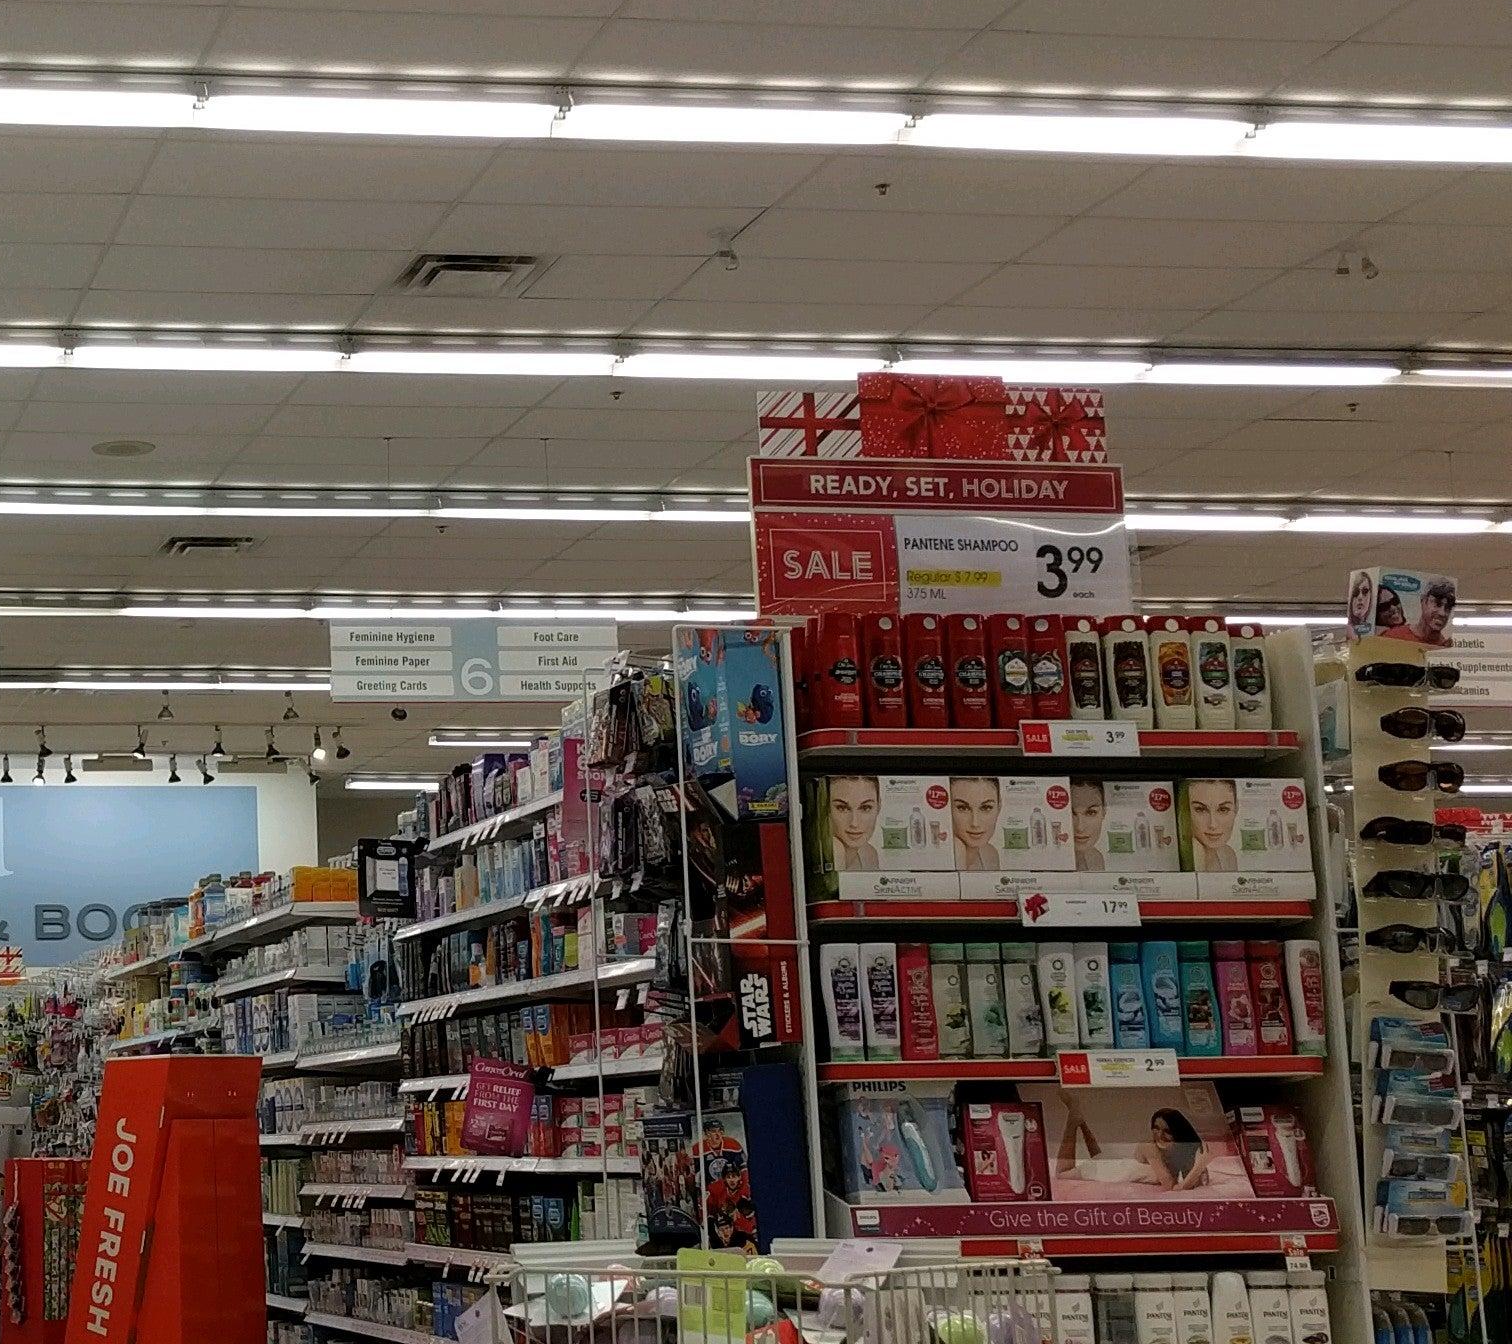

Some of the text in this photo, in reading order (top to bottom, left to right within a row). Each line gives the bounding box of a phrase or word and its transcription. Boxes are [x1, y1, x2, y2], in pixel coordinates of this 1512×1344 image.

[809, 474, 1069, 500] READY, SET, HOLIDAY
[903, 537, 1019, 552] PANTENE SHAMPOO
[783, 550, 873, 580] SALE
[906, 570, 952, 586] Regular
[906, 586, 946, 600] 375 ML
[1072, 590, 1095, 599] each
[349, 632, 435, 644] Feminine Hygiene
[533, 632, 579, 642] Foot Care
[355, 656, 430, 669] Feminine Paper
[538, 656, 578, 667] First Aid
[460, 657, 493, 695] 6
[356, 680, 428, 693] Greeting Cards
[520, 681, 552, 691] Health
[1025, 733, 1049, 743] SALE
[740, 973, 758, 1038] STAR
[754, 973, 773, 1038] WARS
[1064, 1064, 1086, 1074] SALE
[492, 1084, 522, 1096] RELIEF
[852, 1080, 907, 1094] PHILIPS
[473, 1097, 520, 1113] FIRST DAY
[989, 1206, 1204, 1231] Give the Gift of Beauty
[86, 1117, 137, 1337] JOE FRESH
